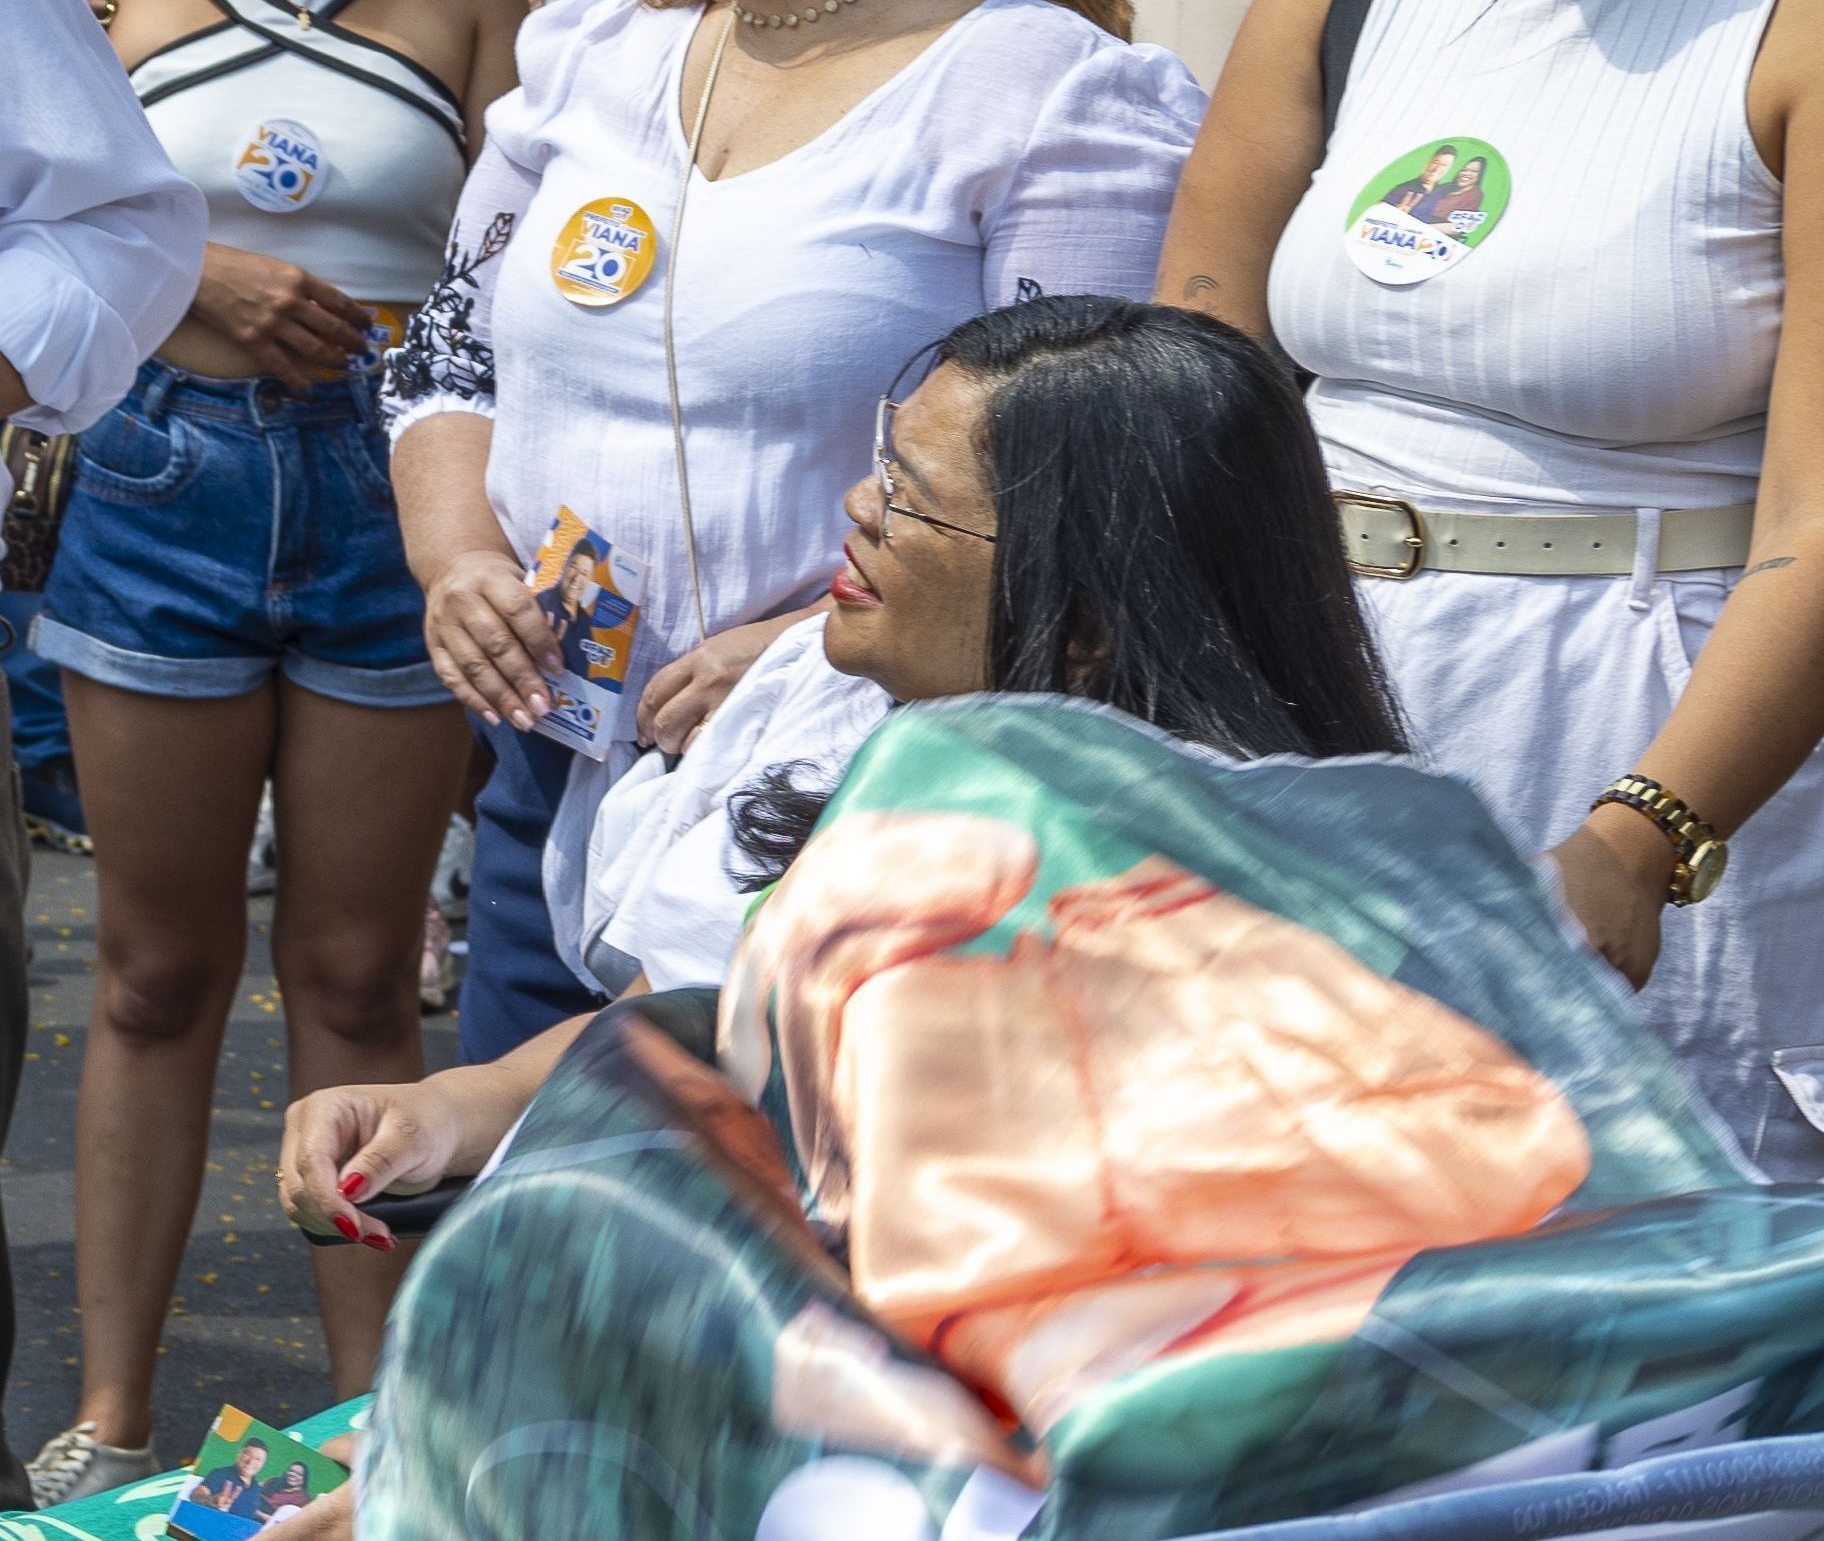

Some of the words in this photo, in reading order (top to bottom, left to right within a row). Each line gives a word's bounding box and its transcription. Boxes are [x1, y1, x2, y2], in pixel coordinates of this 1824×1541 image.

[258, 124, 319, 170] VIANA
[238, 145, 307, 197] 20
[582, 220, 639, 252] VIANA
[1360, 224, 1416, 250] VIANA
[564, 243, 627, 284] 20
